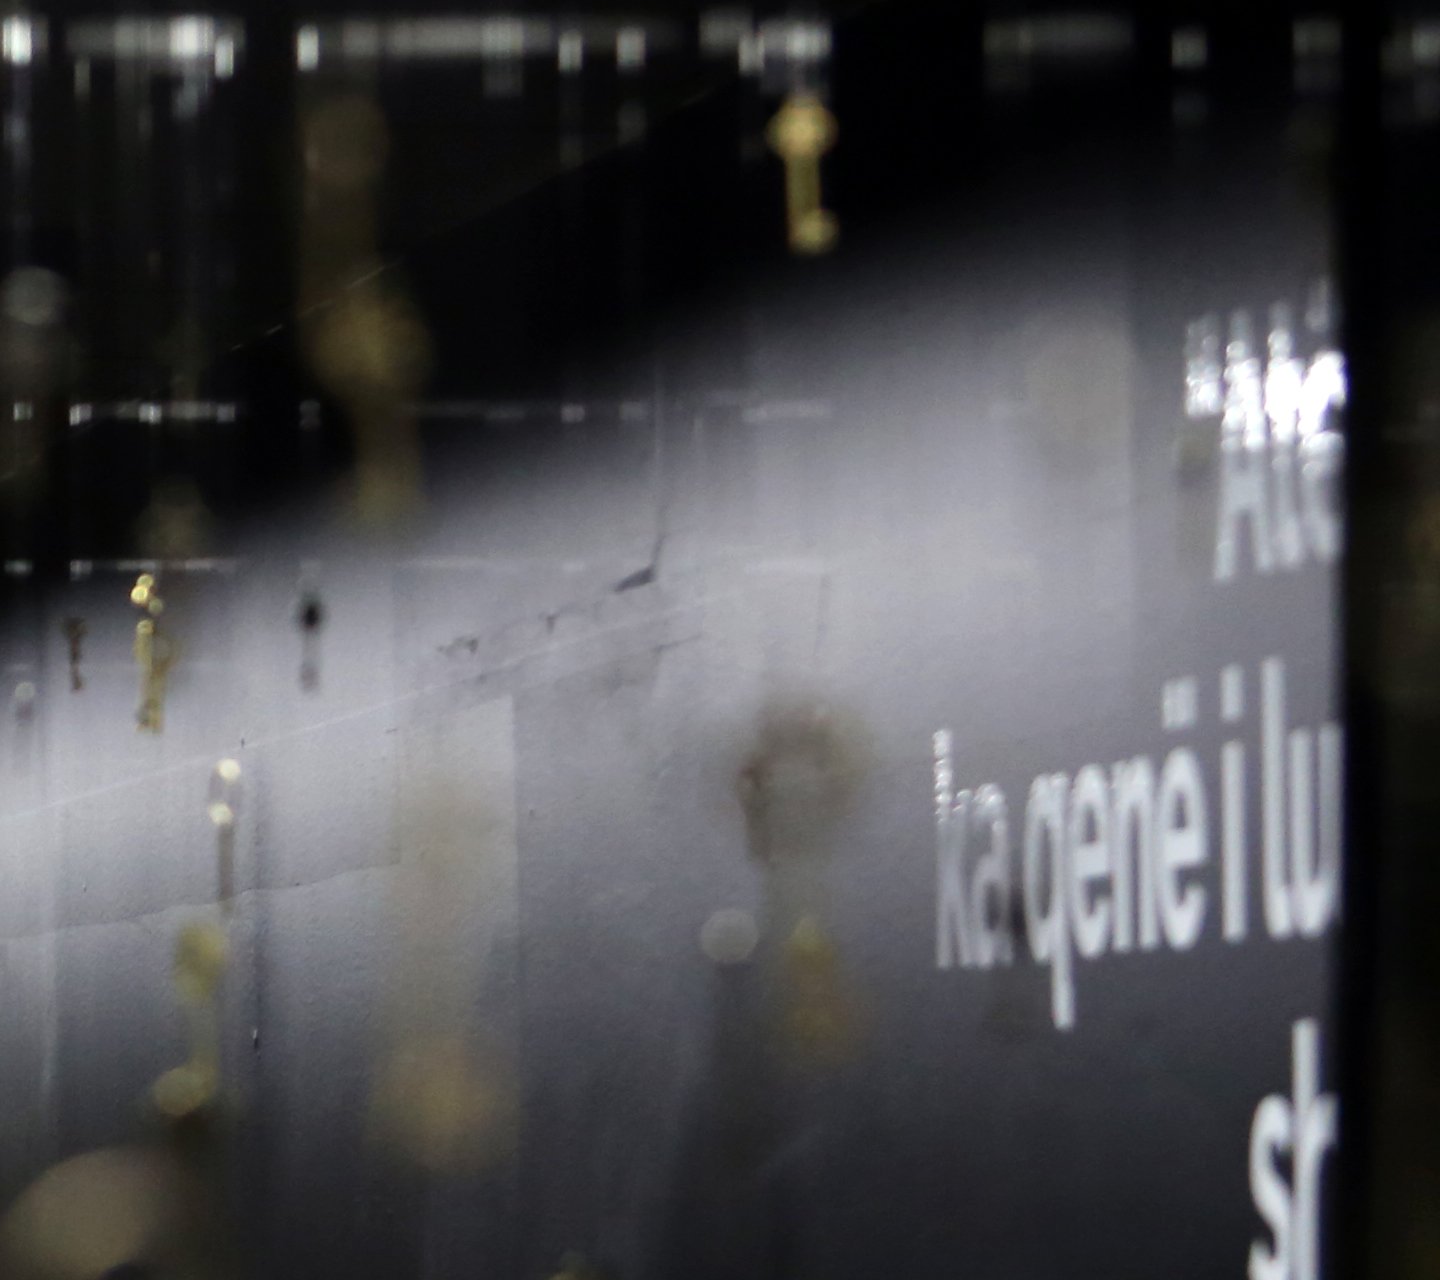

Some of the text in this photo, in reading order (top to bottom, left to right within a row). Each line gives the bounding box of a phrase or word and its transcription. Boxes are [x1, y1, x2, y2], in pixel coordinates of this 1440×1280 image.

[933, 728, 1012, 969] ka
[1024, 676, 1208, 1029] qenë
[1221, 664, 1247, 942] i
